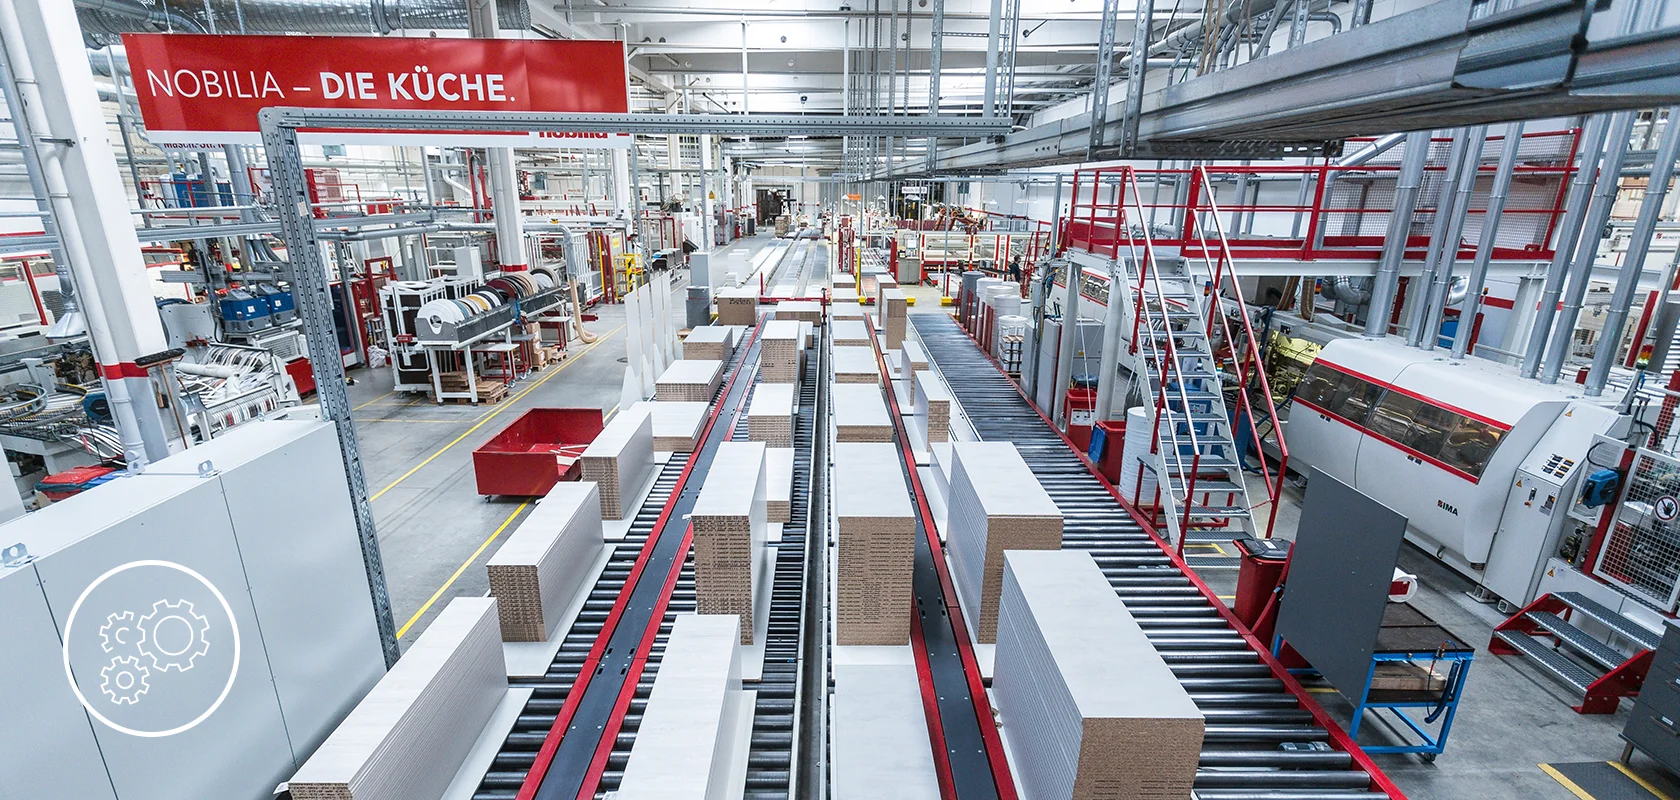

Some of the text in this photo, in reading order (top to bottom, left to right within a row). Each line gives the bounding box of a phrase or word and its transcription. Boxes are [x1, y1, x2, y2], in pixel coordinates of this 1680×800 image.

[146, 69, 285, 99] NOBILIA
[319, 71, 378, 100] DIE
[387, 65, 516, 102] KÜCHE.
